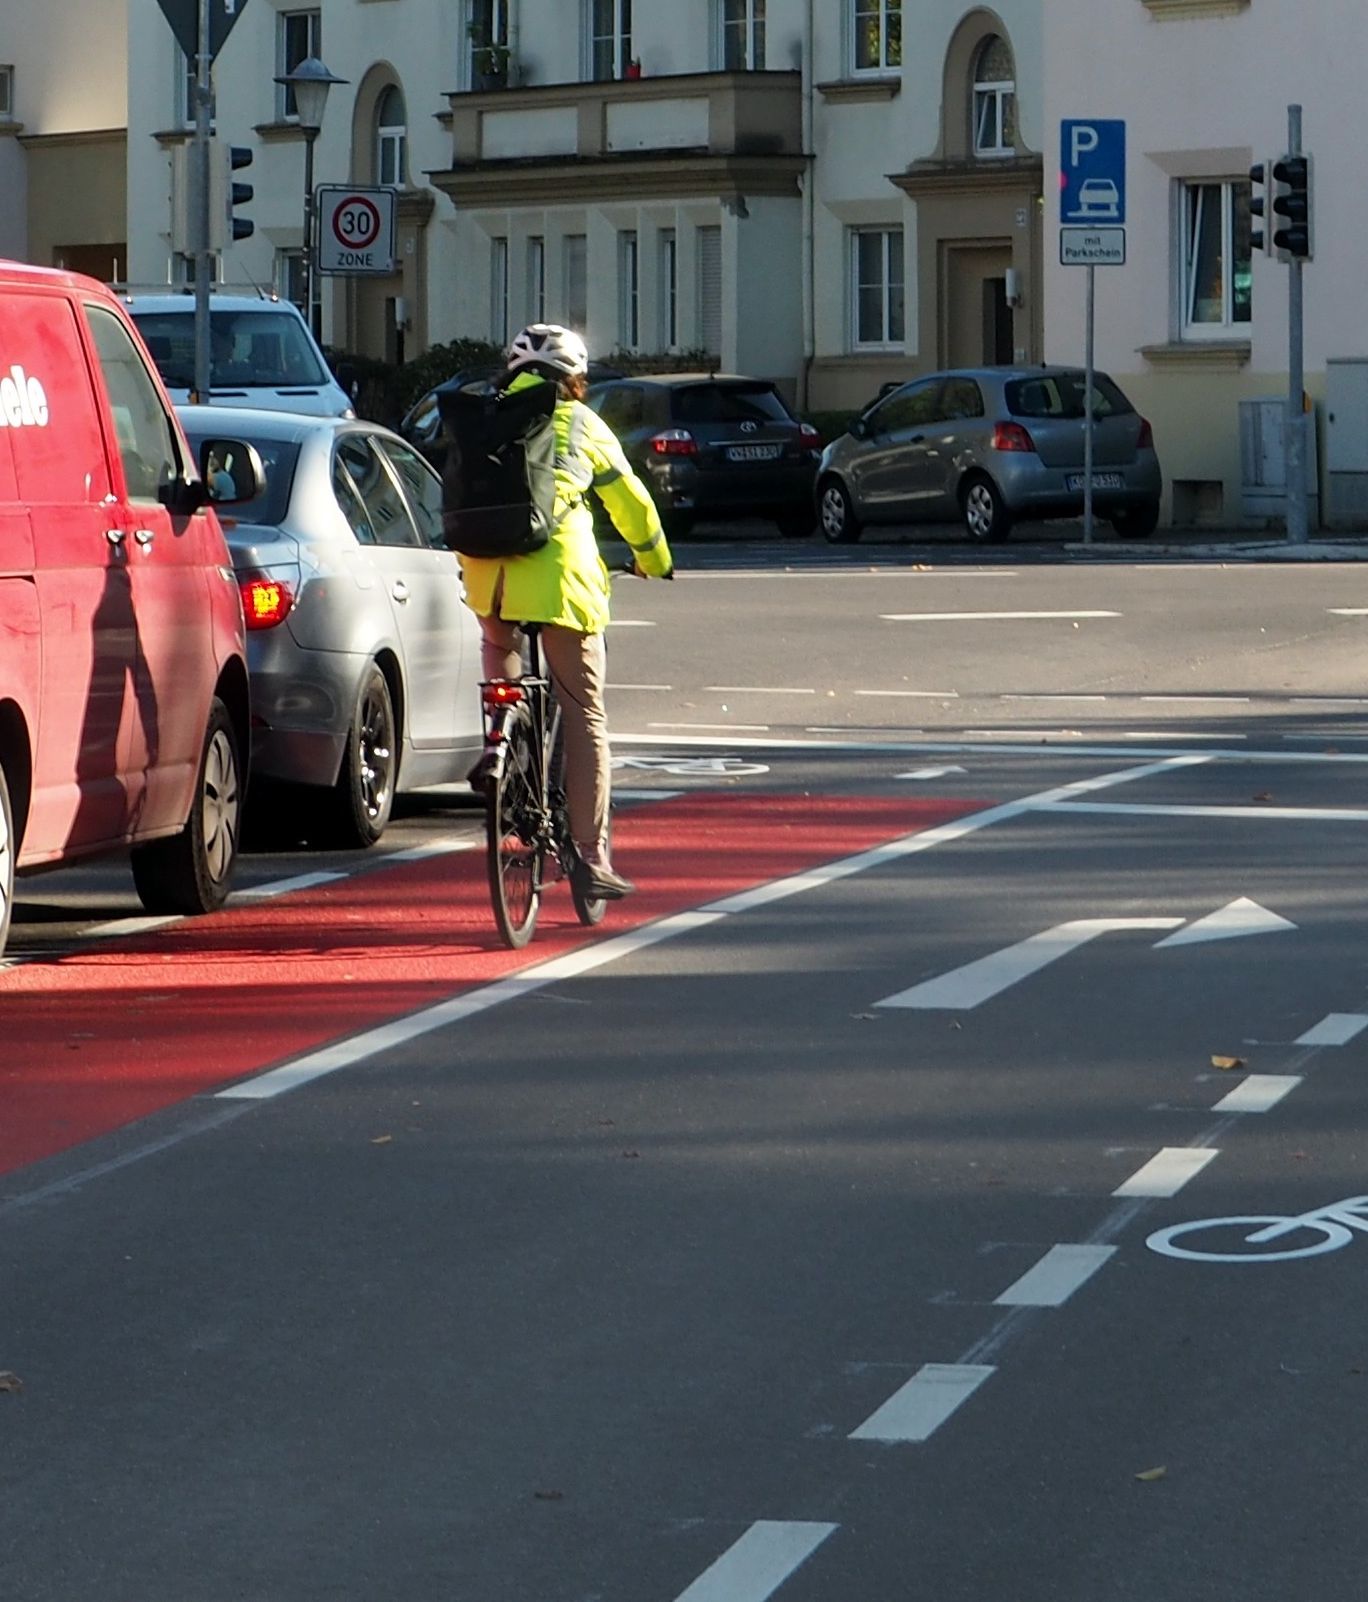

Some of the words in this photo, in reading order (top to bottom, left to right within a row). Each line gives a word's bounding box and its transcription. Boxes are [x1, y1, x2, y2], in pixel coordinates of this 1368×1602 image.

[1071, 125, 1099, 167] P
[343, 211, 370, 235] 30
[1084, 236, 1101, 246] mit
[337, 252, 374, 267] ZONE
[1065, 247, 1121, 258] Parkschein
